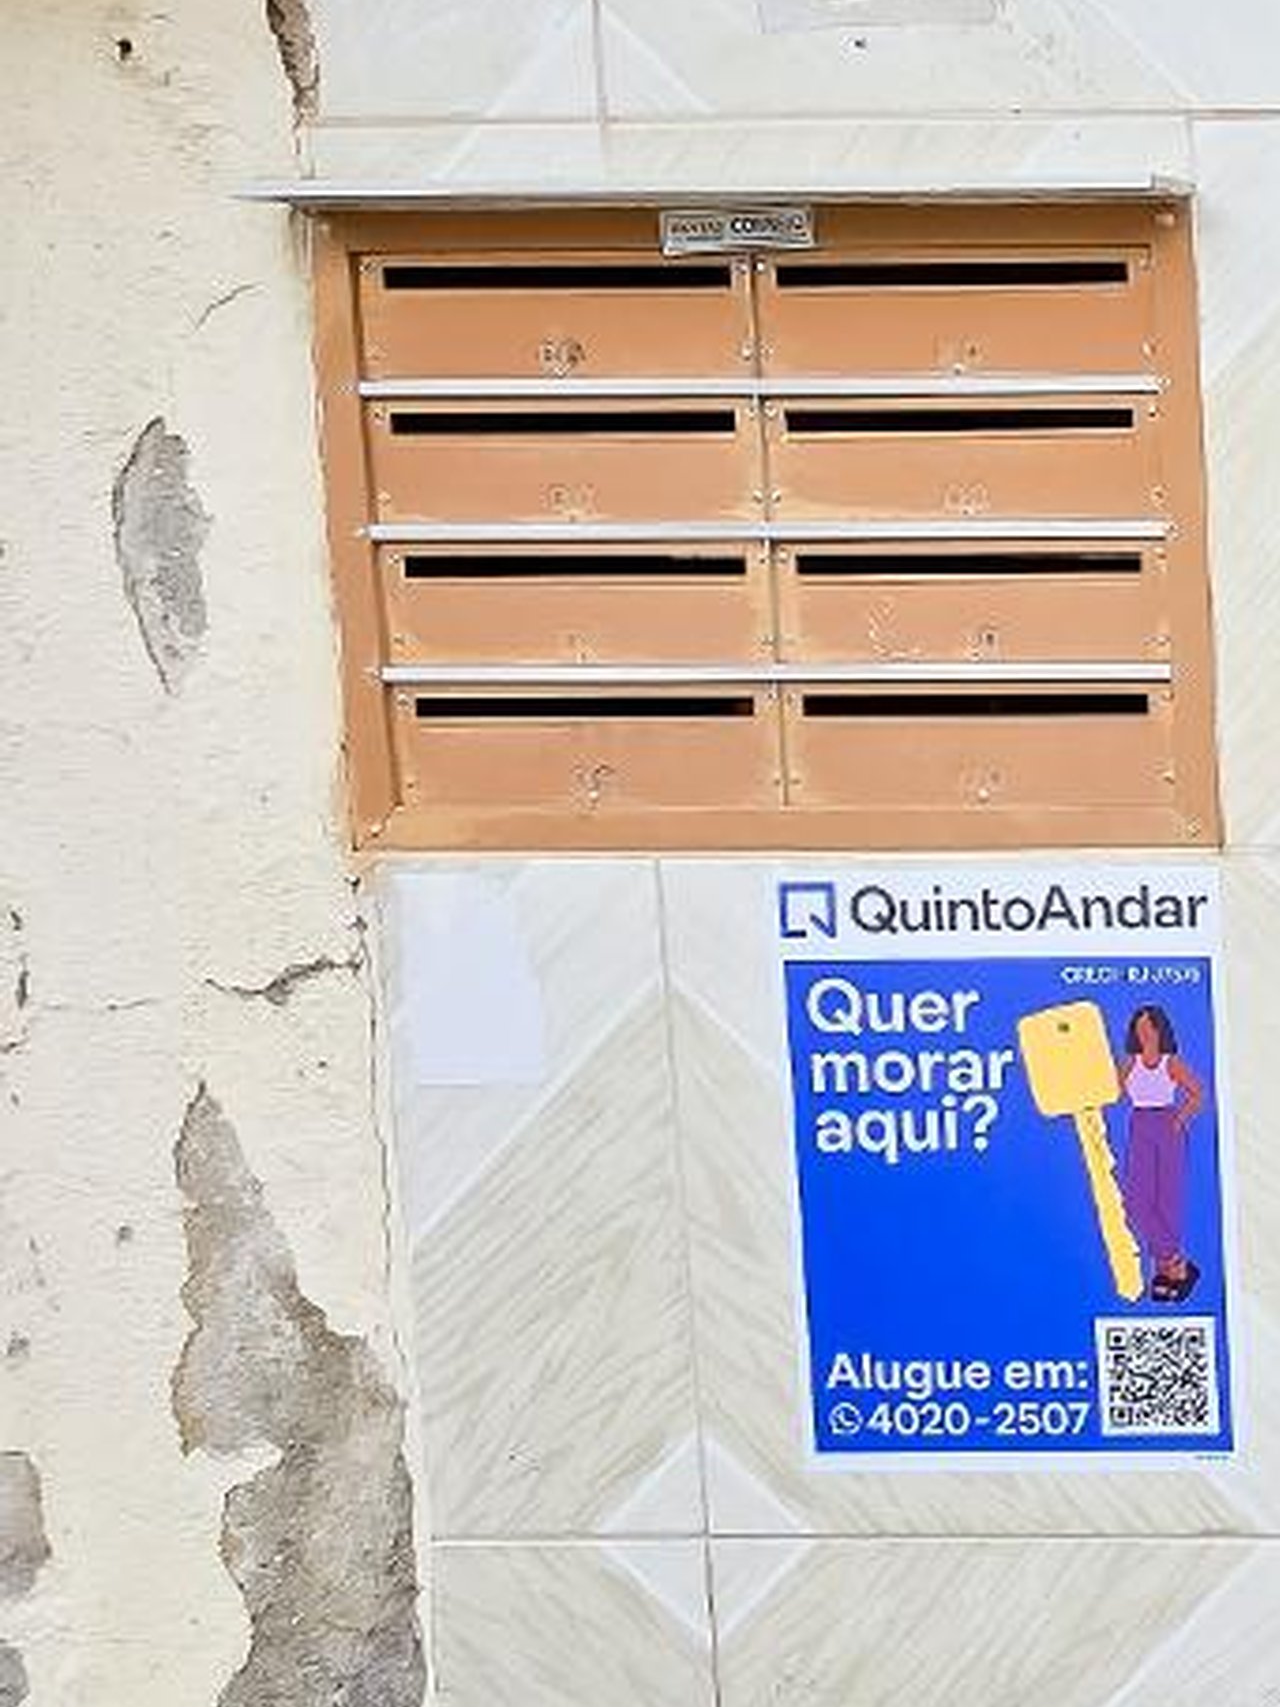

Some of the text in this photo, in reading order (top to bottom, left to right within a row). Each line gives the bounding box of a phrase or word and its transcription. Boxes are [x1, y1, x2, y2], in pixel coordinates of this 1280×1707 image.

[849, 885, 1208, 934] QuintoAndar
[806, 977, 980, 1036] Quer
[811, 1047, 1014, 1093] morar
[815, 1095, 998, 1165] aqui?
[826, 1352, 1088, 1398] Alugue em:
[867, 1401, 1090, 1436] 4020-2507
